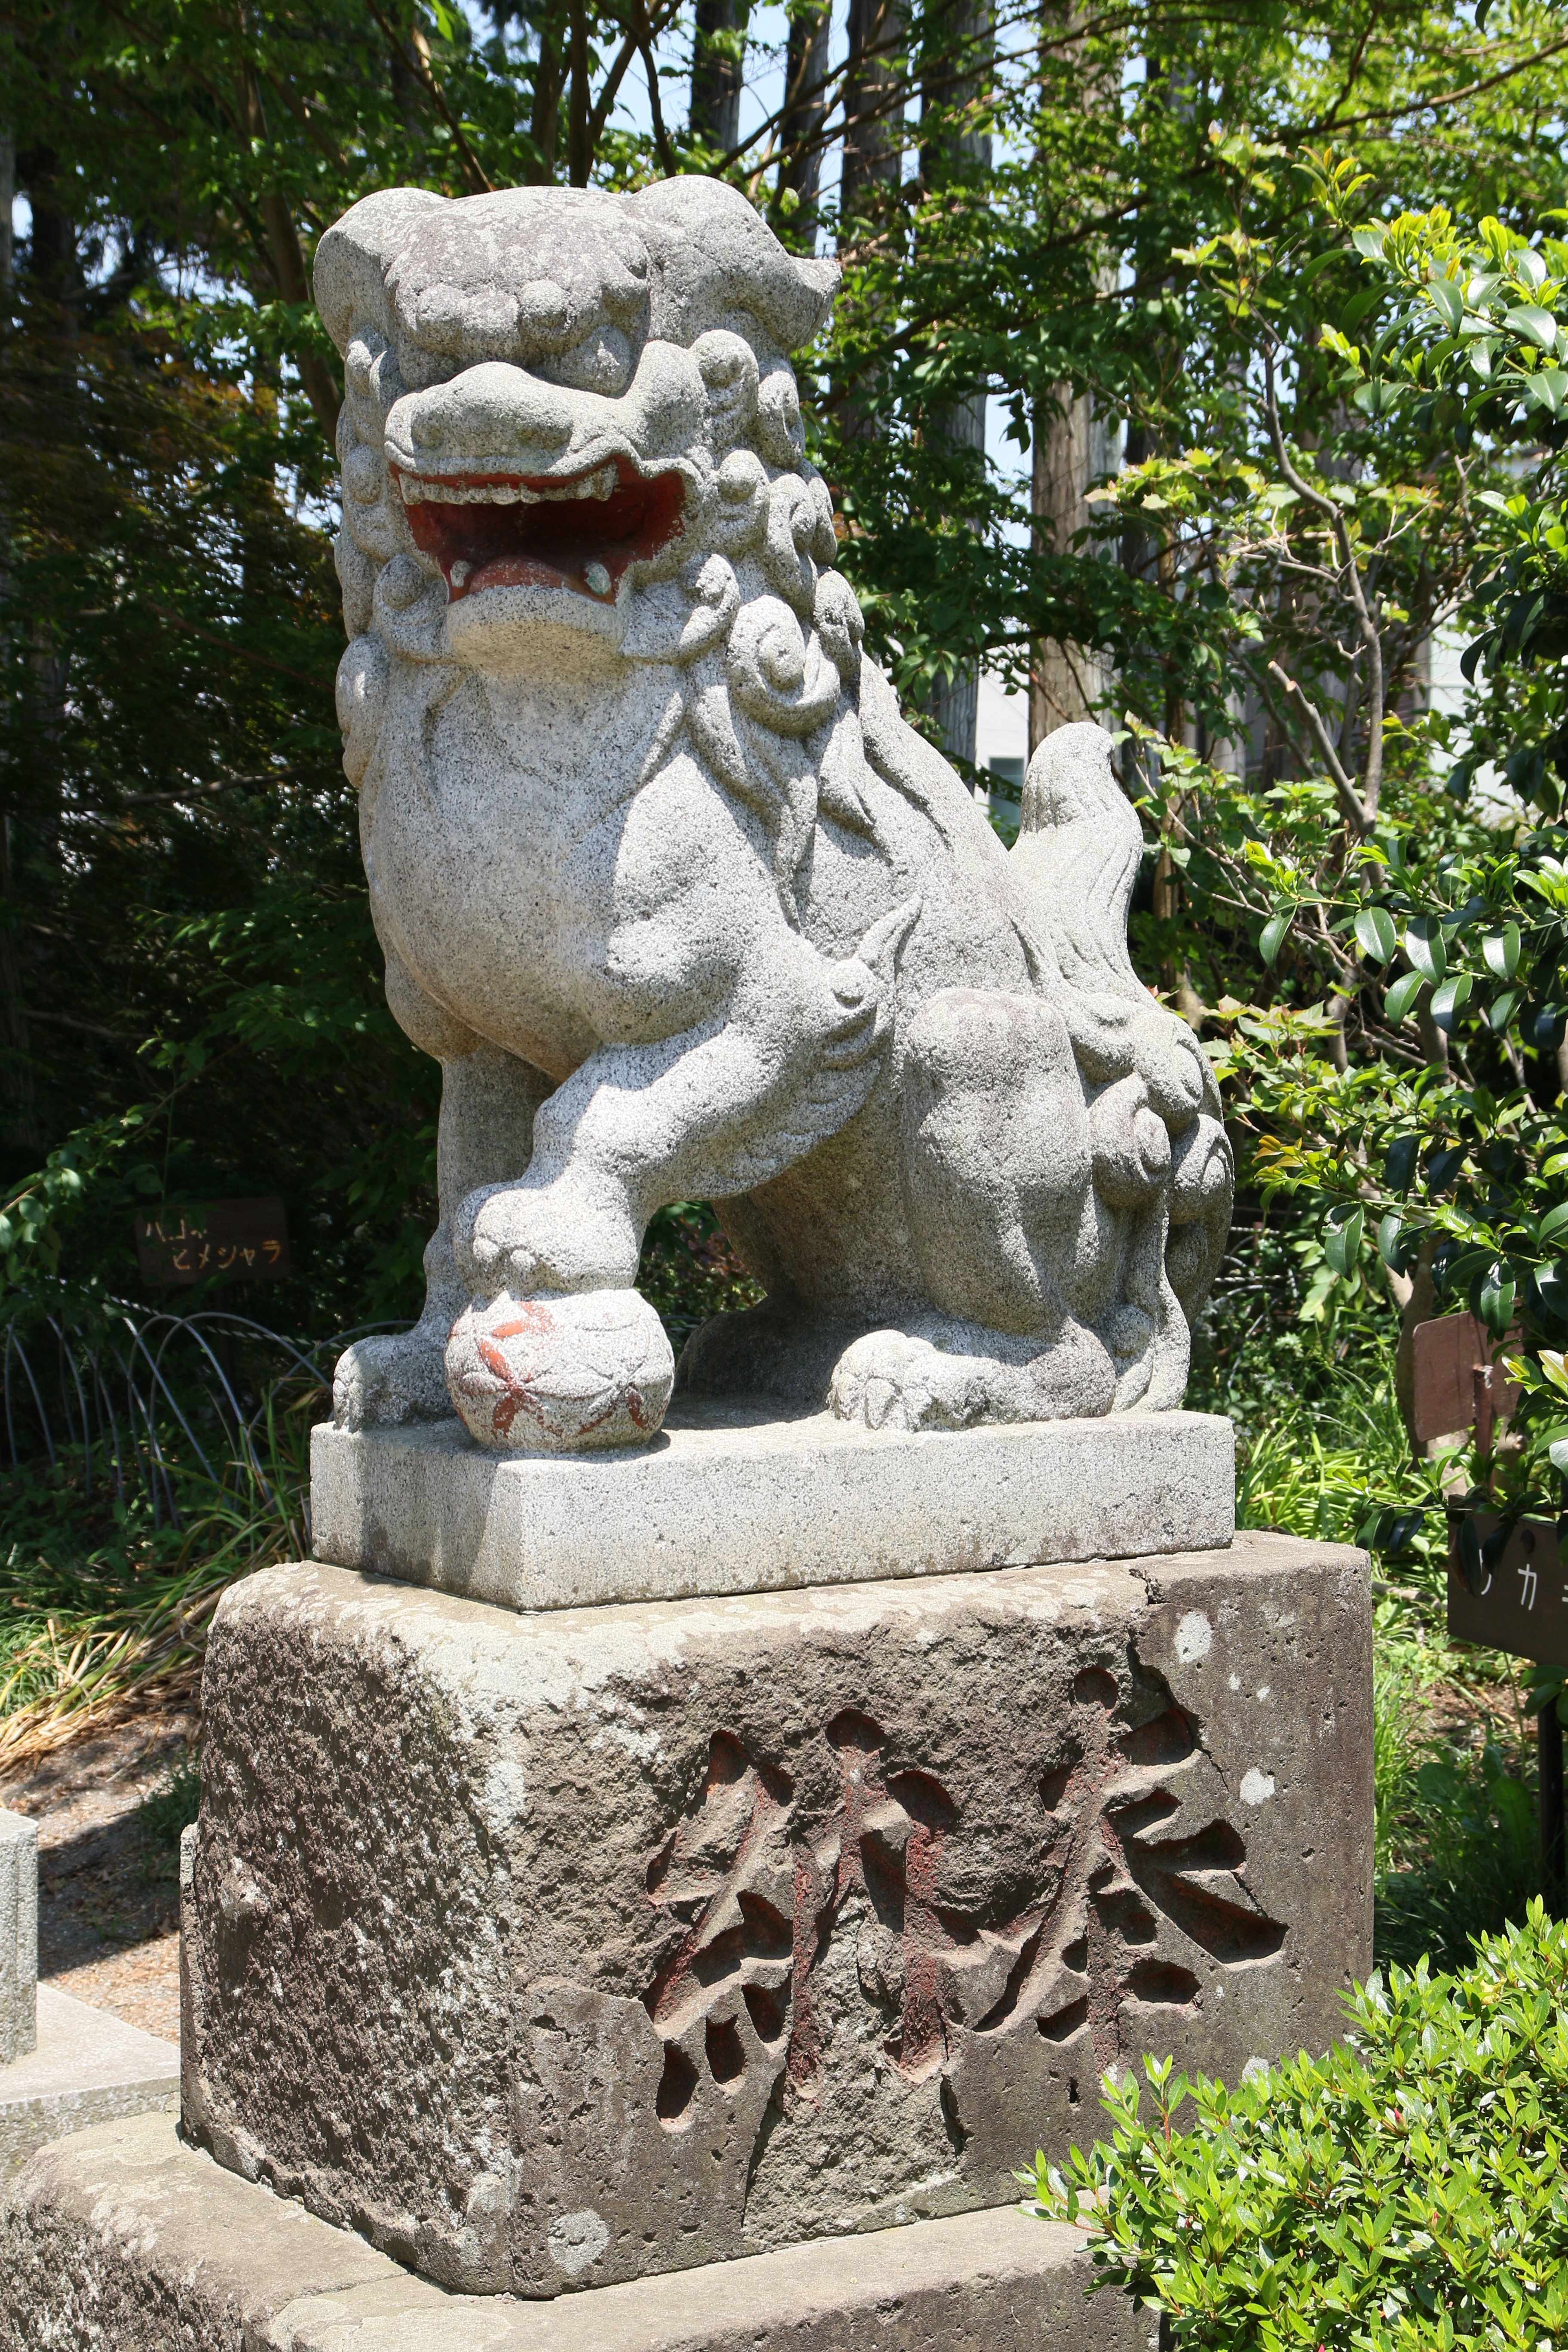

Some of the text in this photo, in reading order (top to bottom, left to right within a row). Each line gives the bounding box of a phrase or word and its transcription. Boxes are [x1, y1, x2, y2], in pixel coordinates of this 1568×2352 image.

[145, 1218, 208, 1242] ハコ
[172, 1239, 282, 1270] ヒメシャラ
